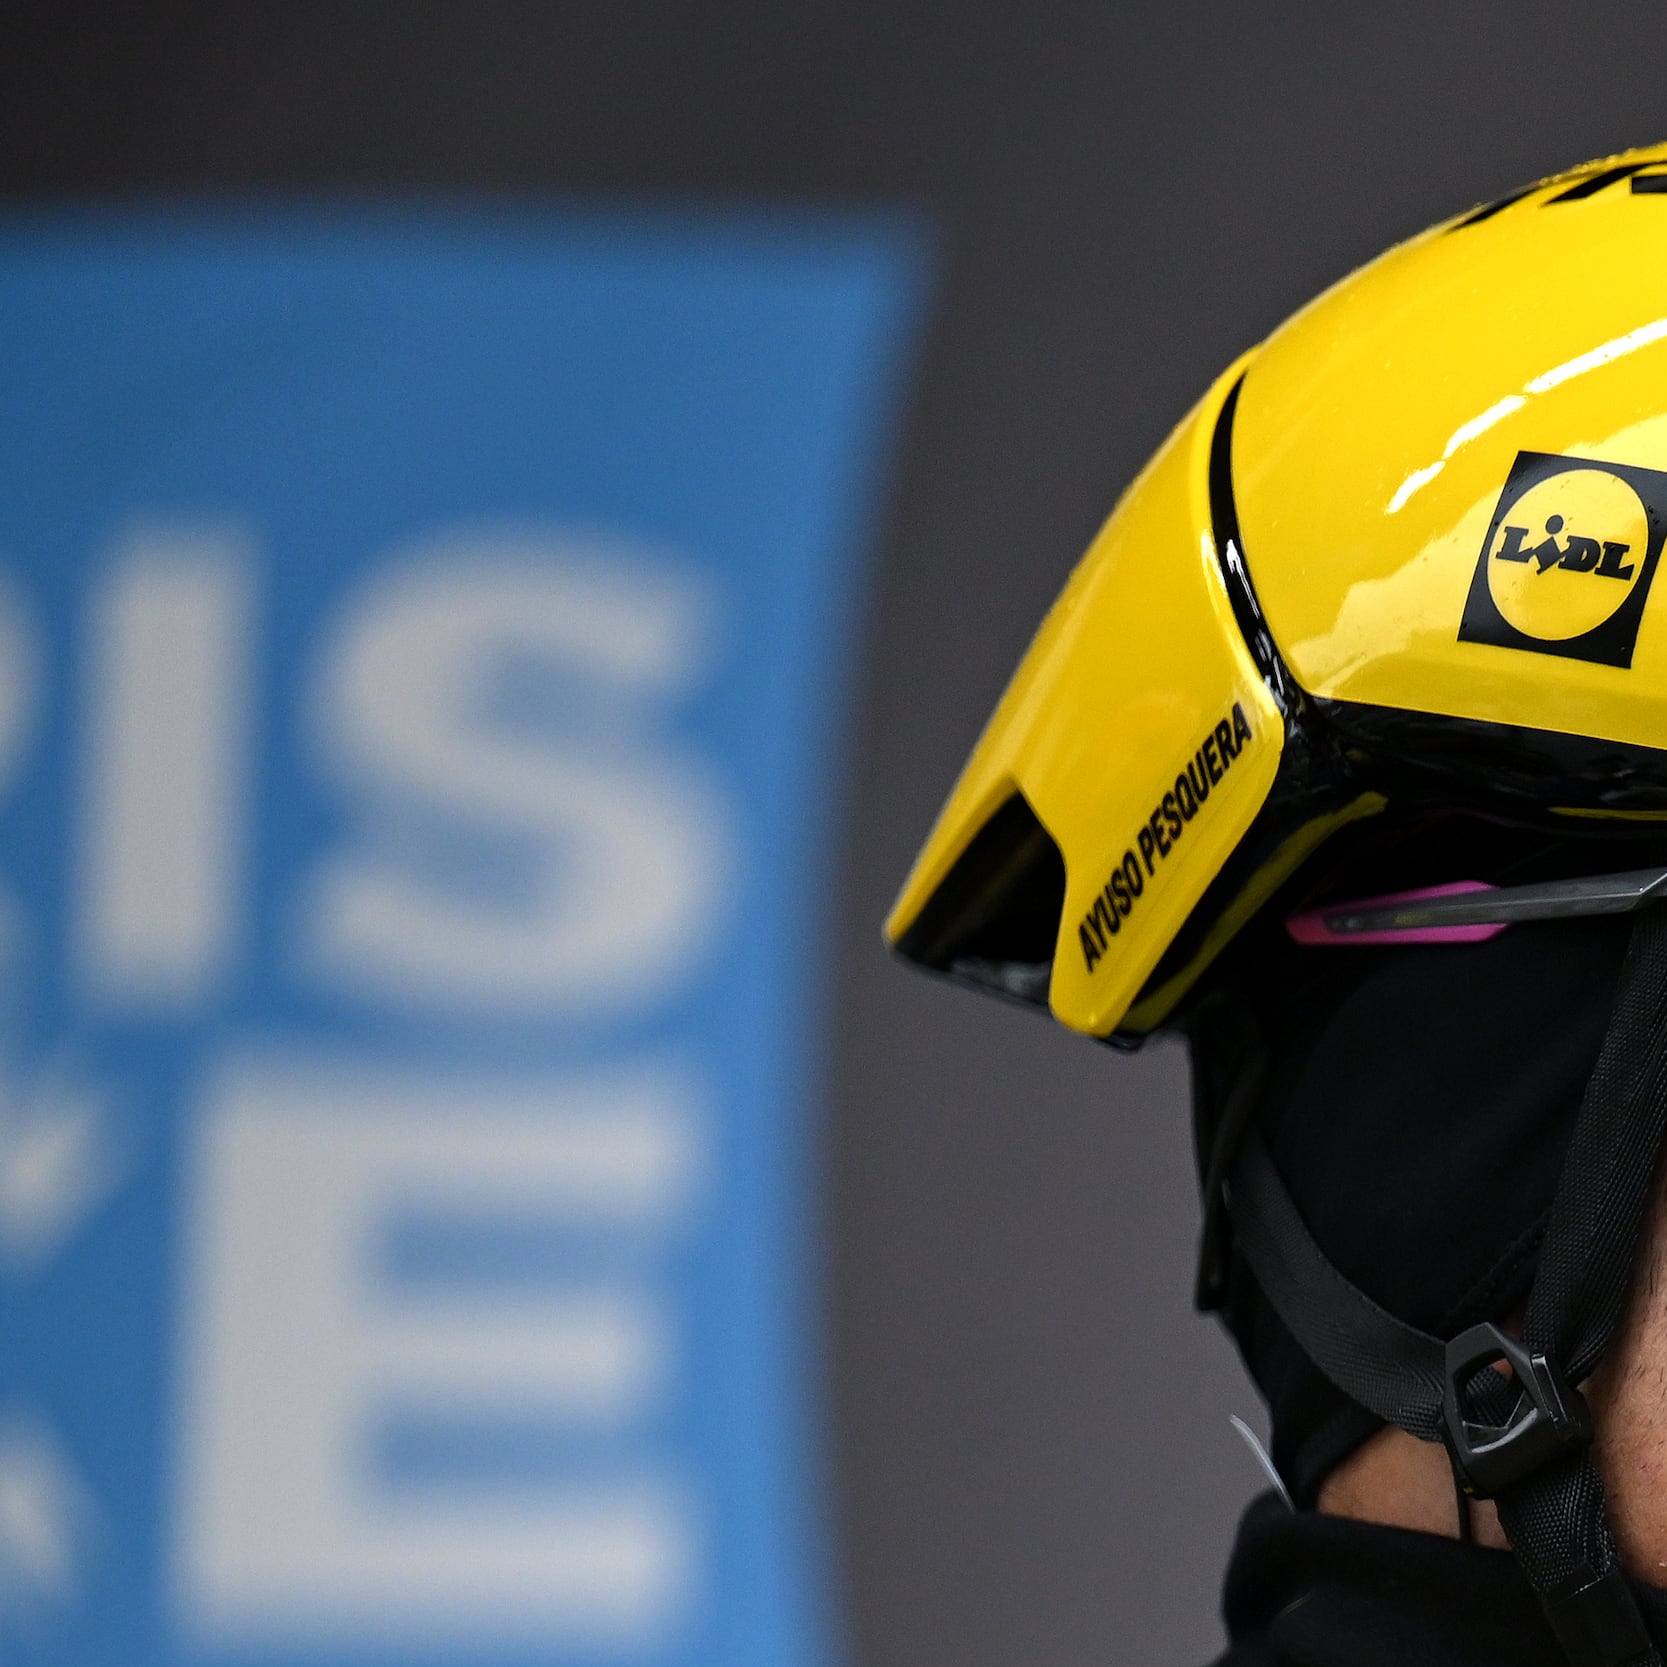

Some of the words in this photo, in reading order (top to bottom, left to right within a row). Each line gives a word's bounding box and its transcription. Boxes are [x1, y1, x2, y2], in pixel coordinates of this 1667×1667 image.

[0, 530, 735, 1012] IS
[1077, 851, 1144, 973] AYUSO
[1137, 701, 1252, 876] PESQUERA
